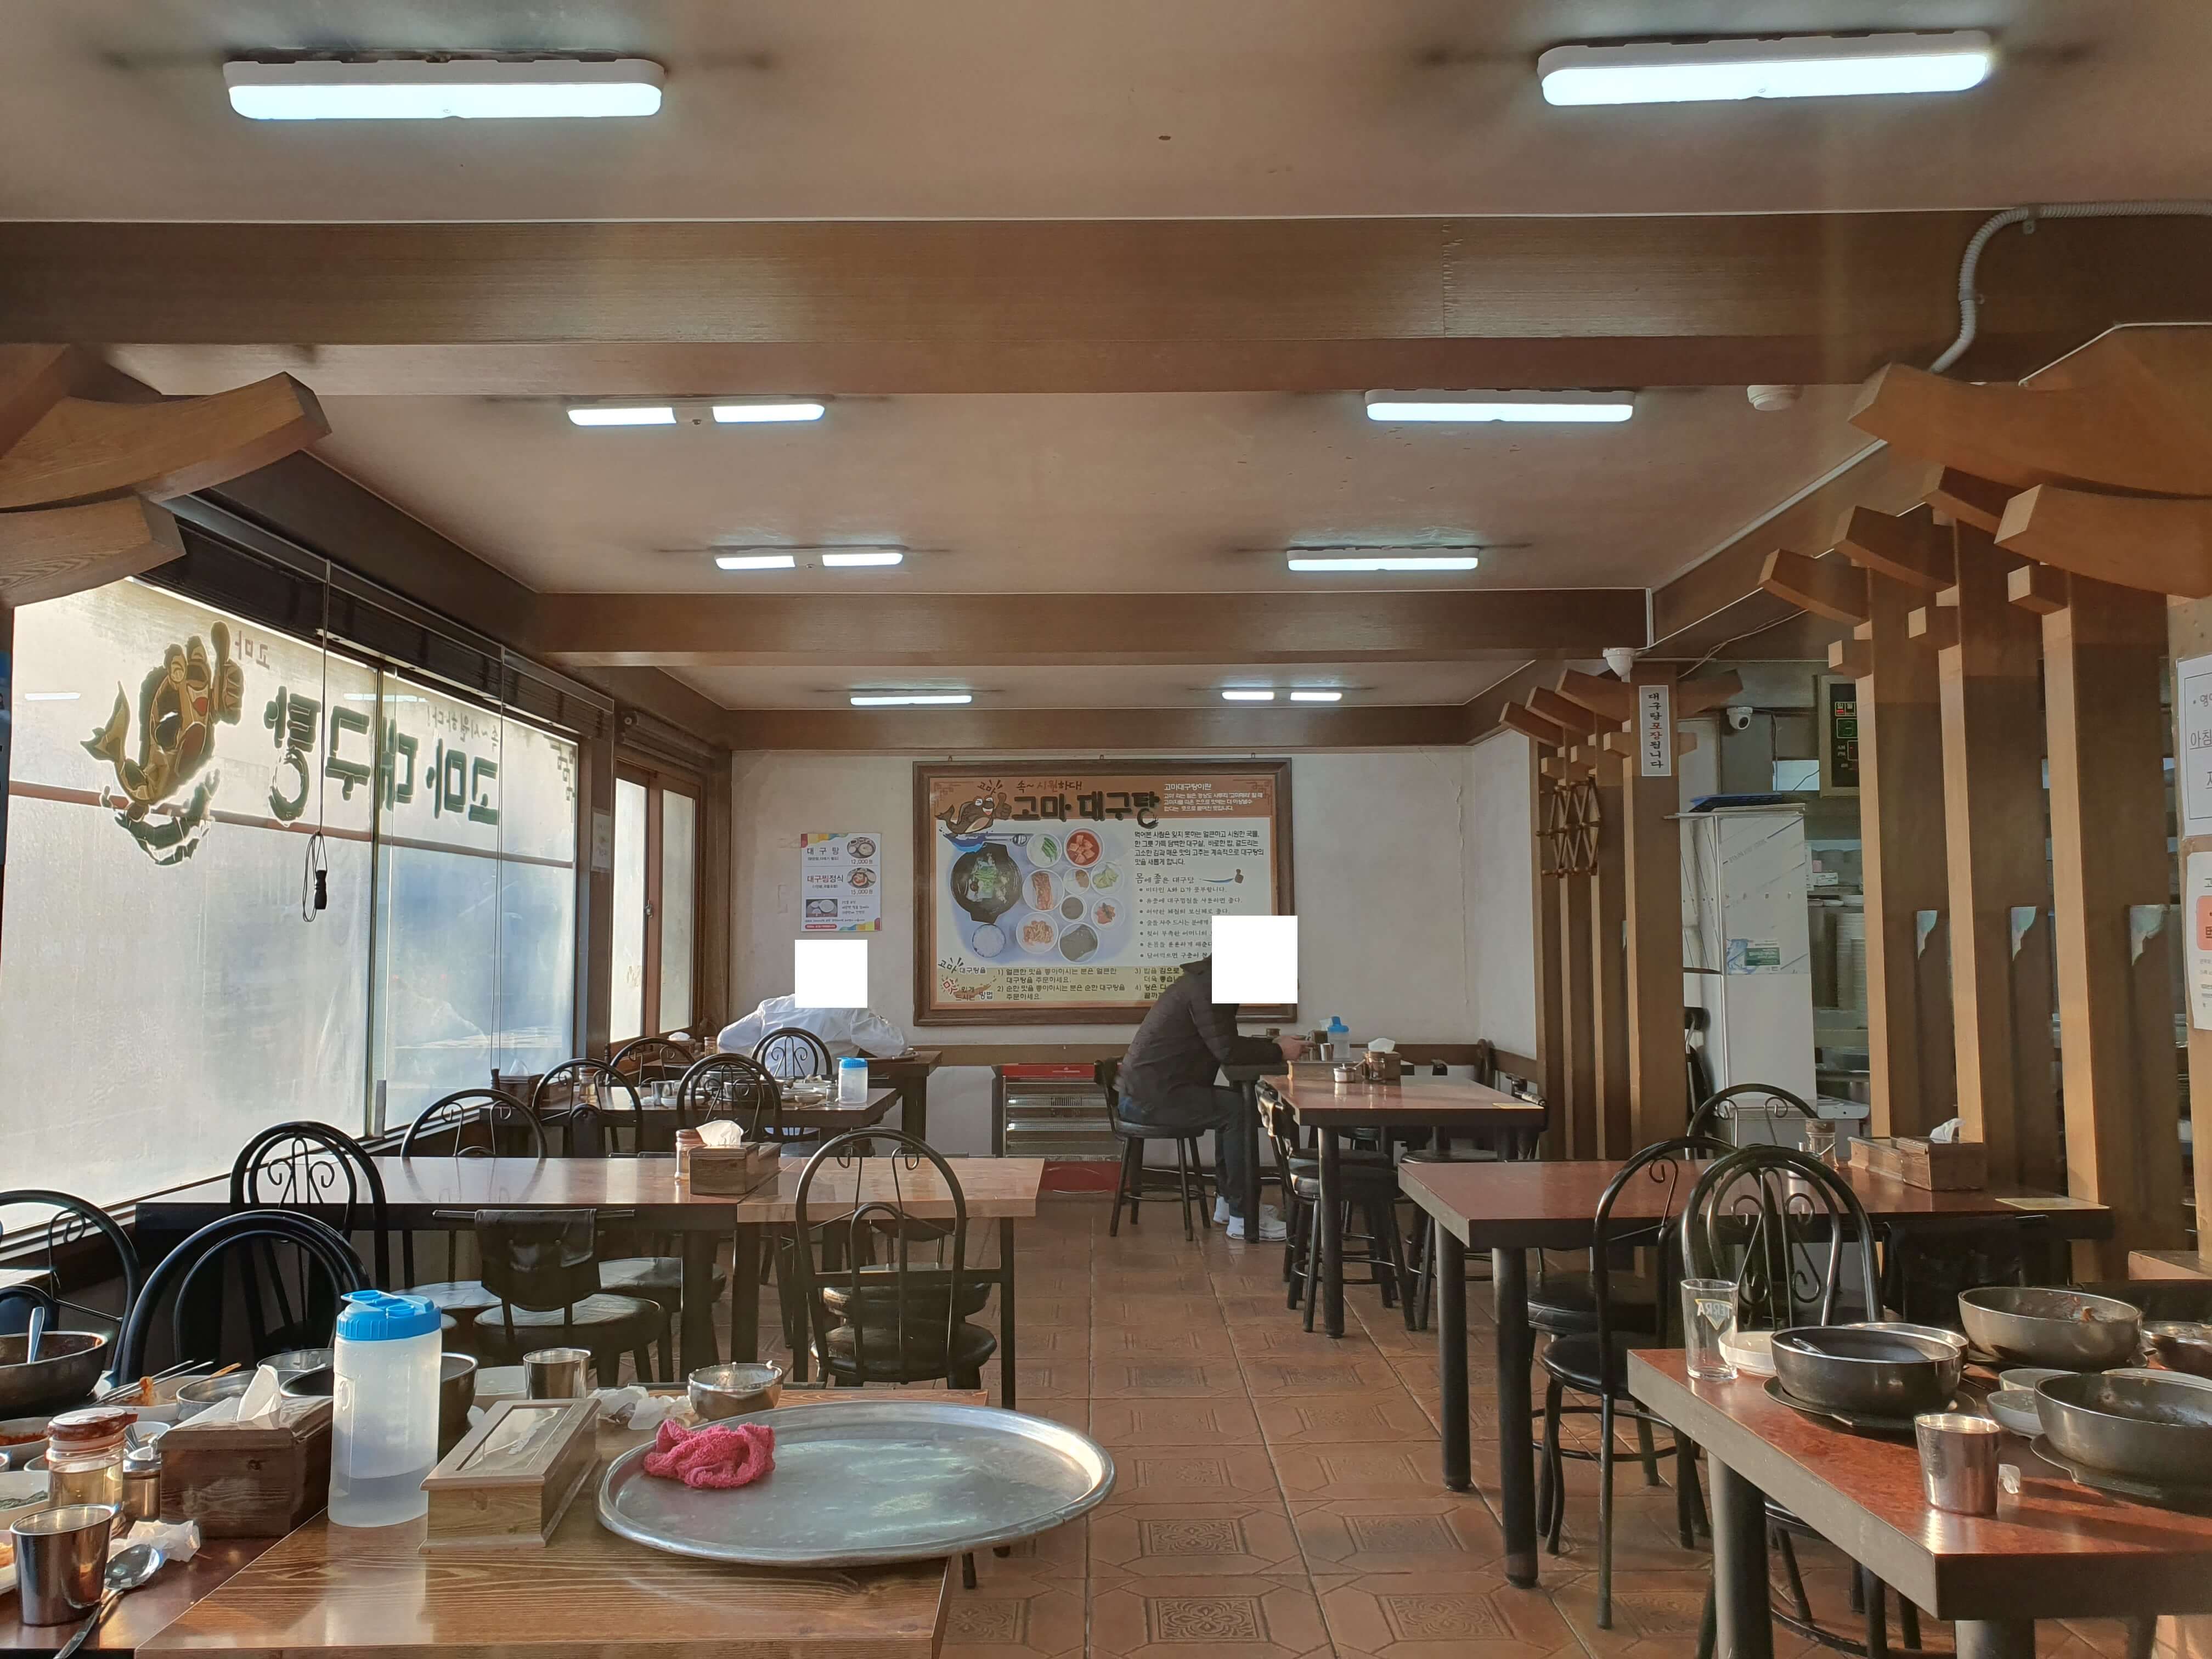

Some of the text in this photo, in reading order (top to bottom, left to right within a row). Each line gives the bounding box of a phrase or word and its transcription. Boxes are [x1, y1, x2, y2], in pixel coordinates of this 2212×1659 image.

[1012, 791, 1160, 829] 고마 대구탕
[1172, 831, 1183, 839] 잊지
[1228, 830, 1245, 838] 시원한
[1136, 872, 1194, 884] 몸에 좋은 대구탕
[938, 960, 957, 974] 고마
[1099, 983, 1125, 991] 대구탕을
[979, 991, 994, 1000] 방법
